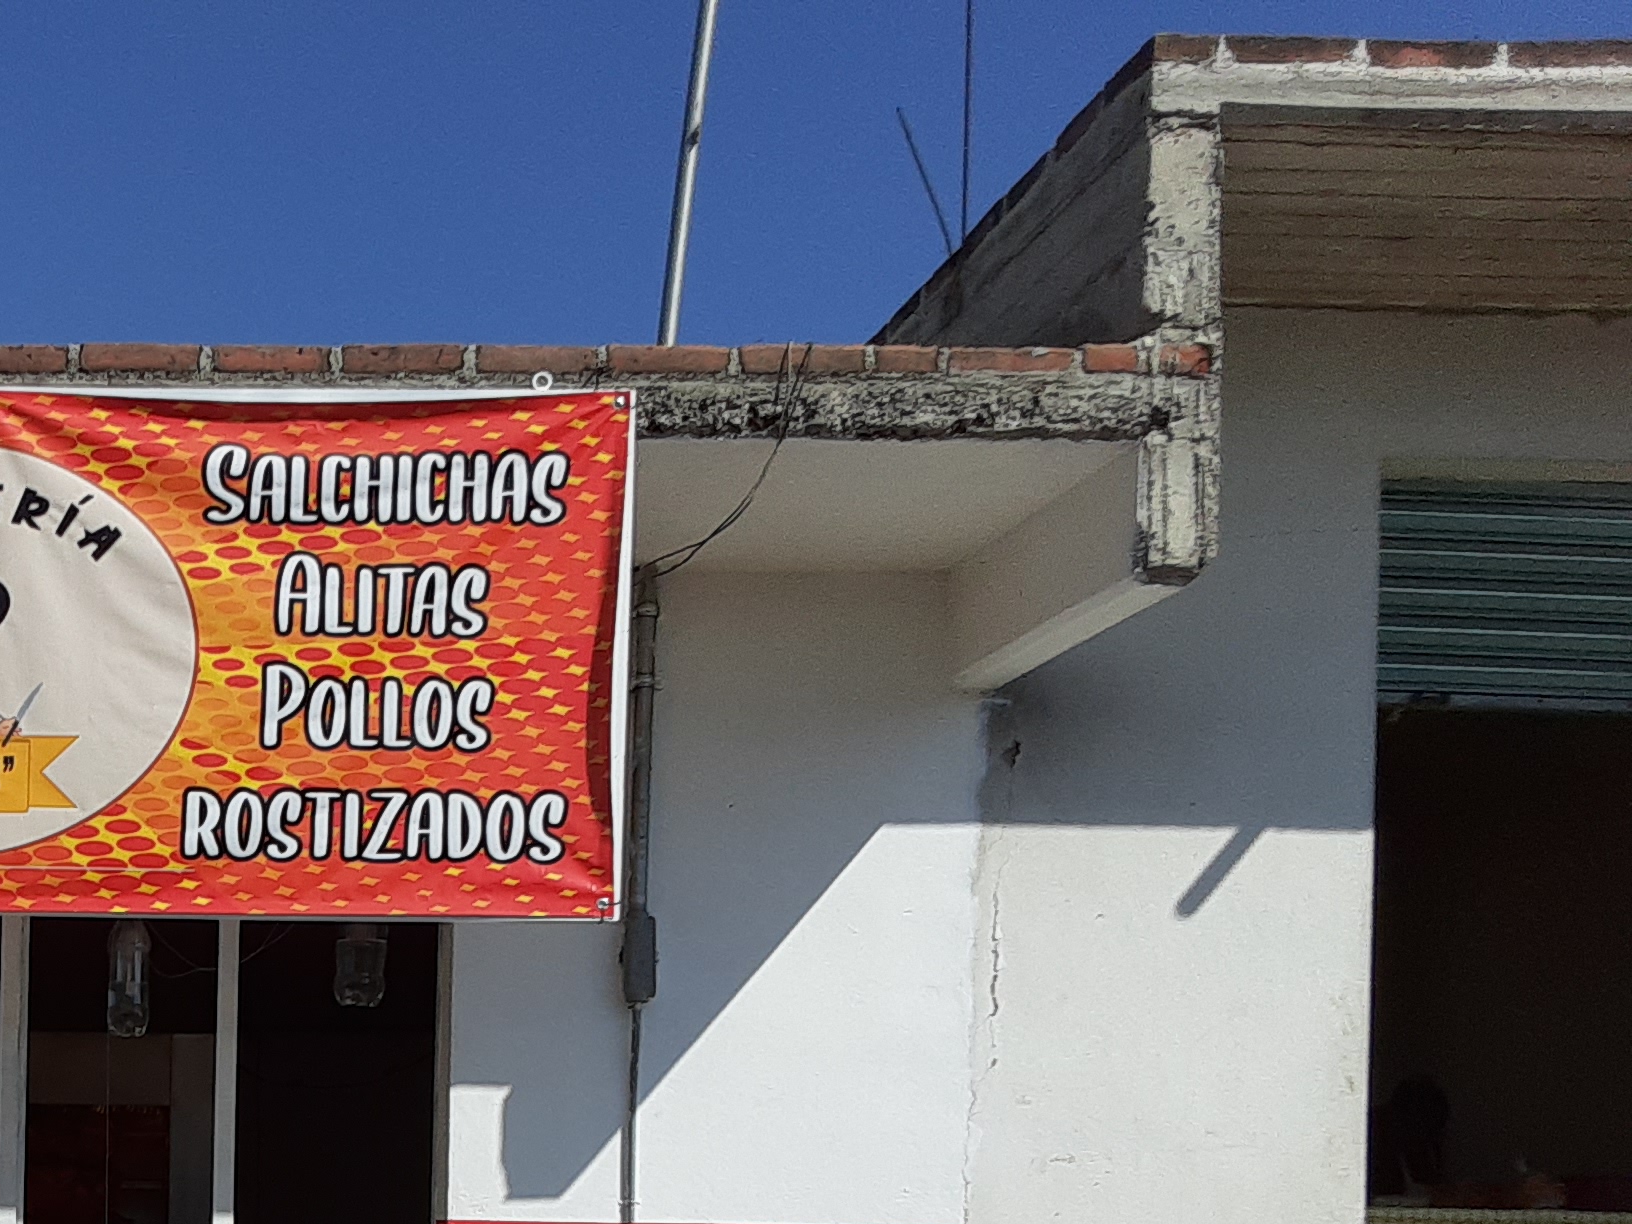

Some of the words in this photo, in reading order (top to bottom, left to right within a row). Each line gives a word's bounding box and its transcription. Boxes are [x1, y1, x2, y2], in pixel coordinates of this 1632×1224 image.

[202, 442, 569, 526] SALCHICHAS
[274, 550, 491, 639] ALITAS
[259, 658, 495, 751] POLLOS
[179, 786, 568, 863] ROSTIZADOS
